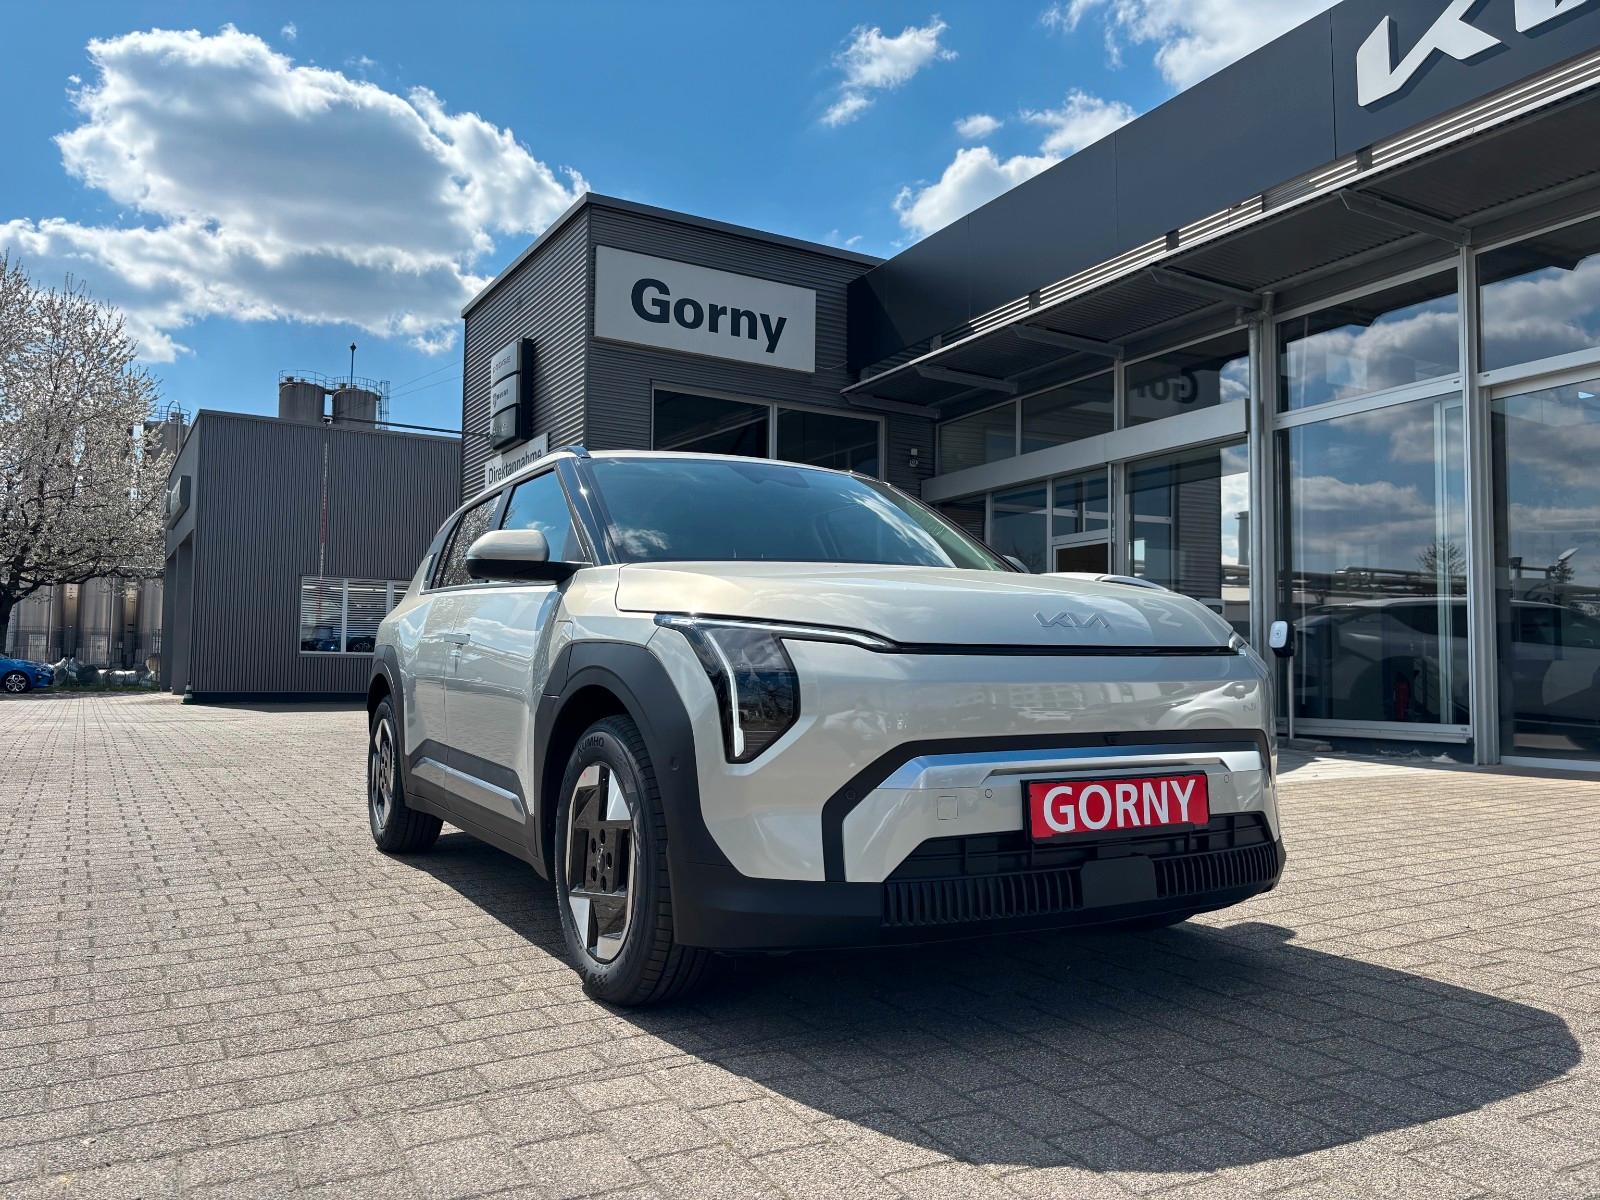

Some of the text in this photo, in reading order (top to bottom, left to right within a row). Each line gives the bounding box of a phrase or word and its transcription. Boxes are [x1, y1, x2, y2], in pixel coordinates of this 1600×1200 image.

[631, 278, 787, 353] Gorny
[1033, 610, 1110, 628] KIA
[1043, 779, 1196, 833] GORNY
